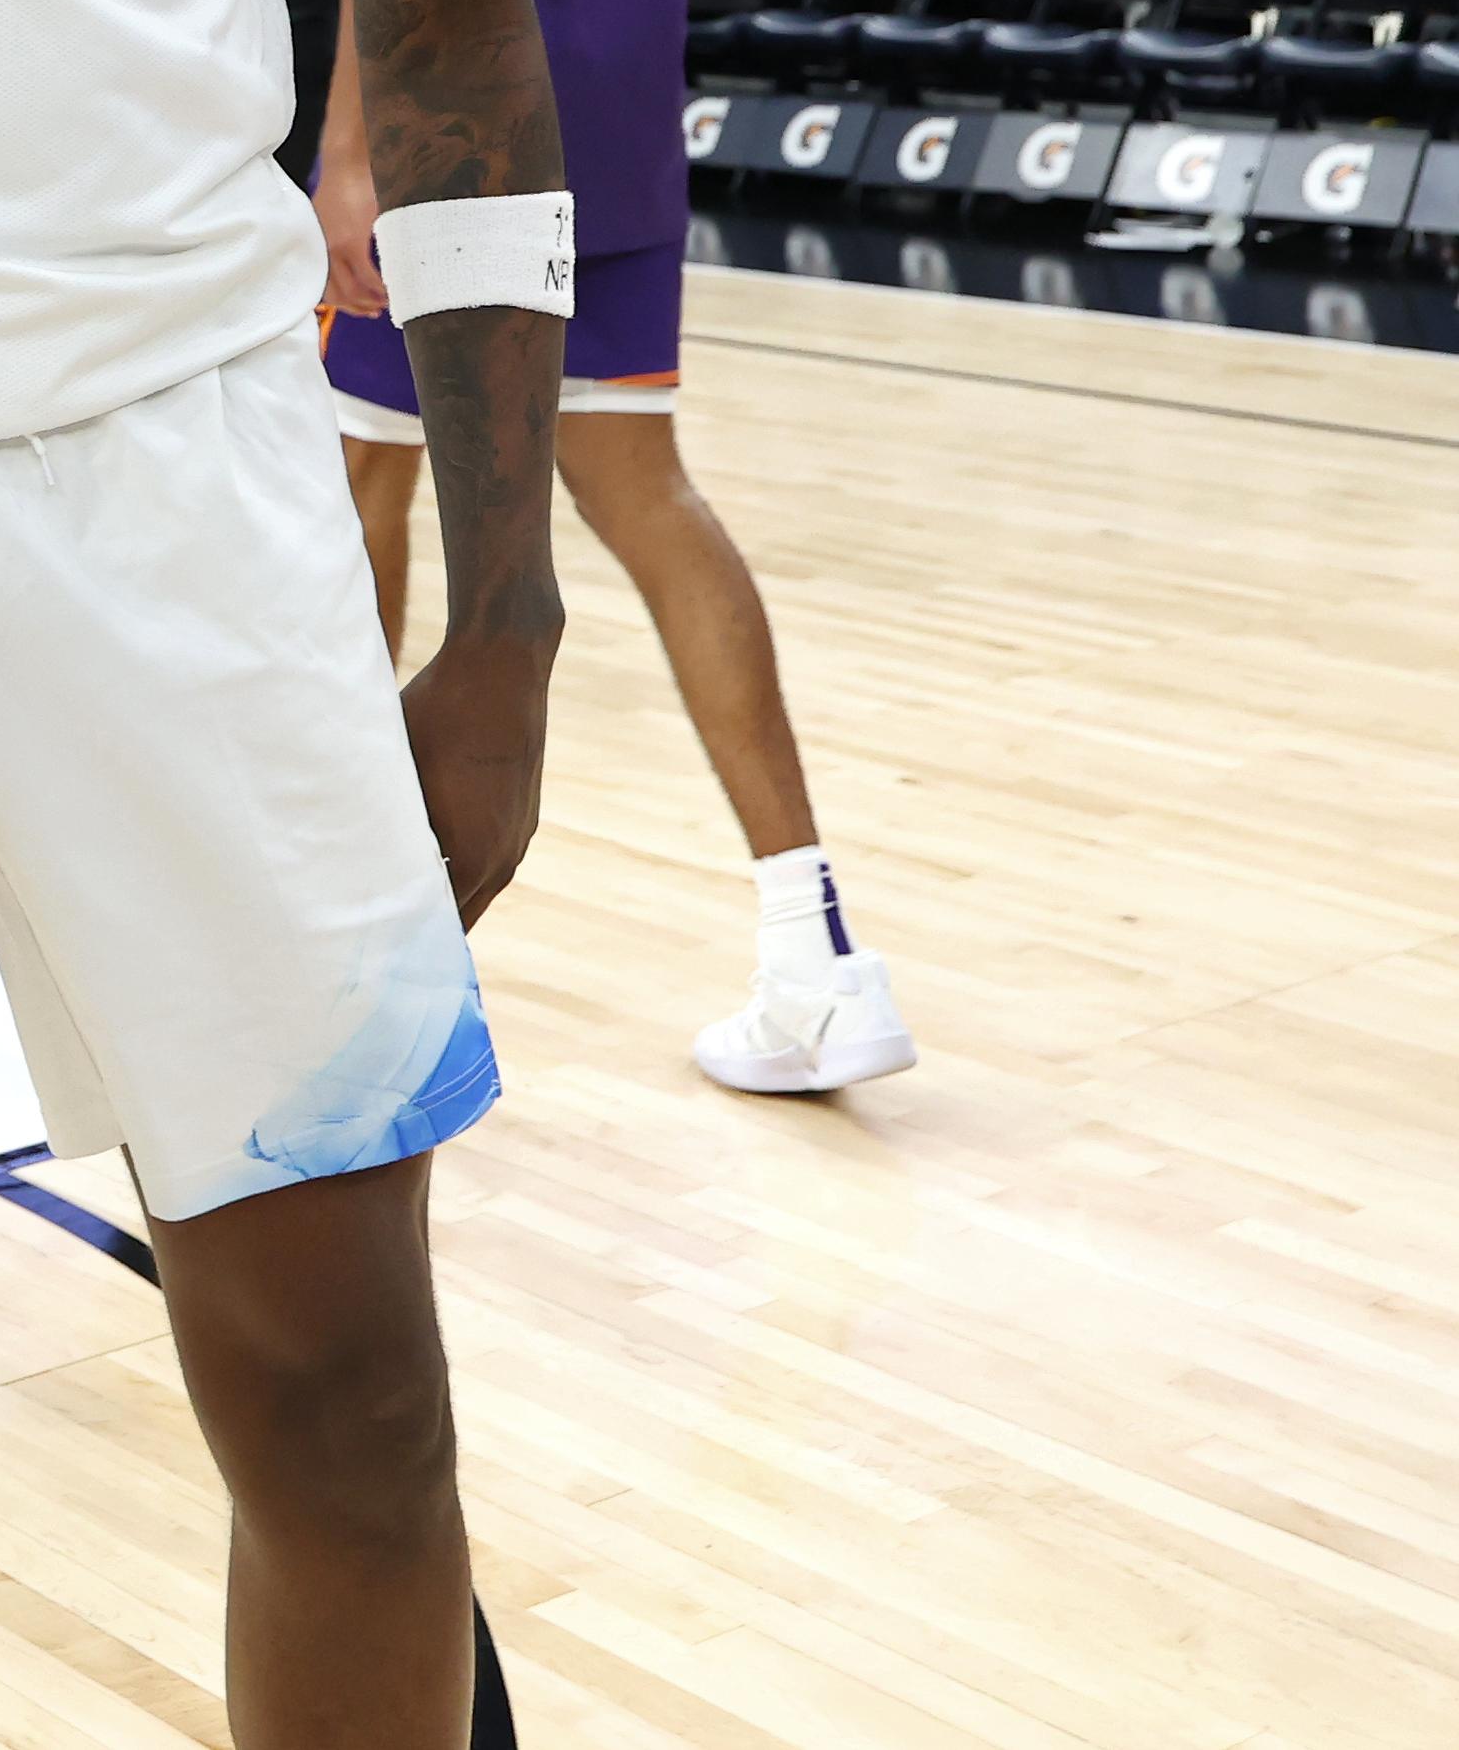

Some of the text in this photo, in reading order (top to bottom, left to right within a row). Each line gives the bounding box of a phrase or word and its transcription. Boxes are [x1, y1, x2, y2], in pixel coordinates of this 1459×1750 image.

[683, 96, 731, 159] G
[781, 104, 841, 168] G
[896, 116, 959, 182] G
[1017, 121, 1082, 191] G
[1155, 136, 1226, 203] G
[1301, 142, 1375, 214] G
